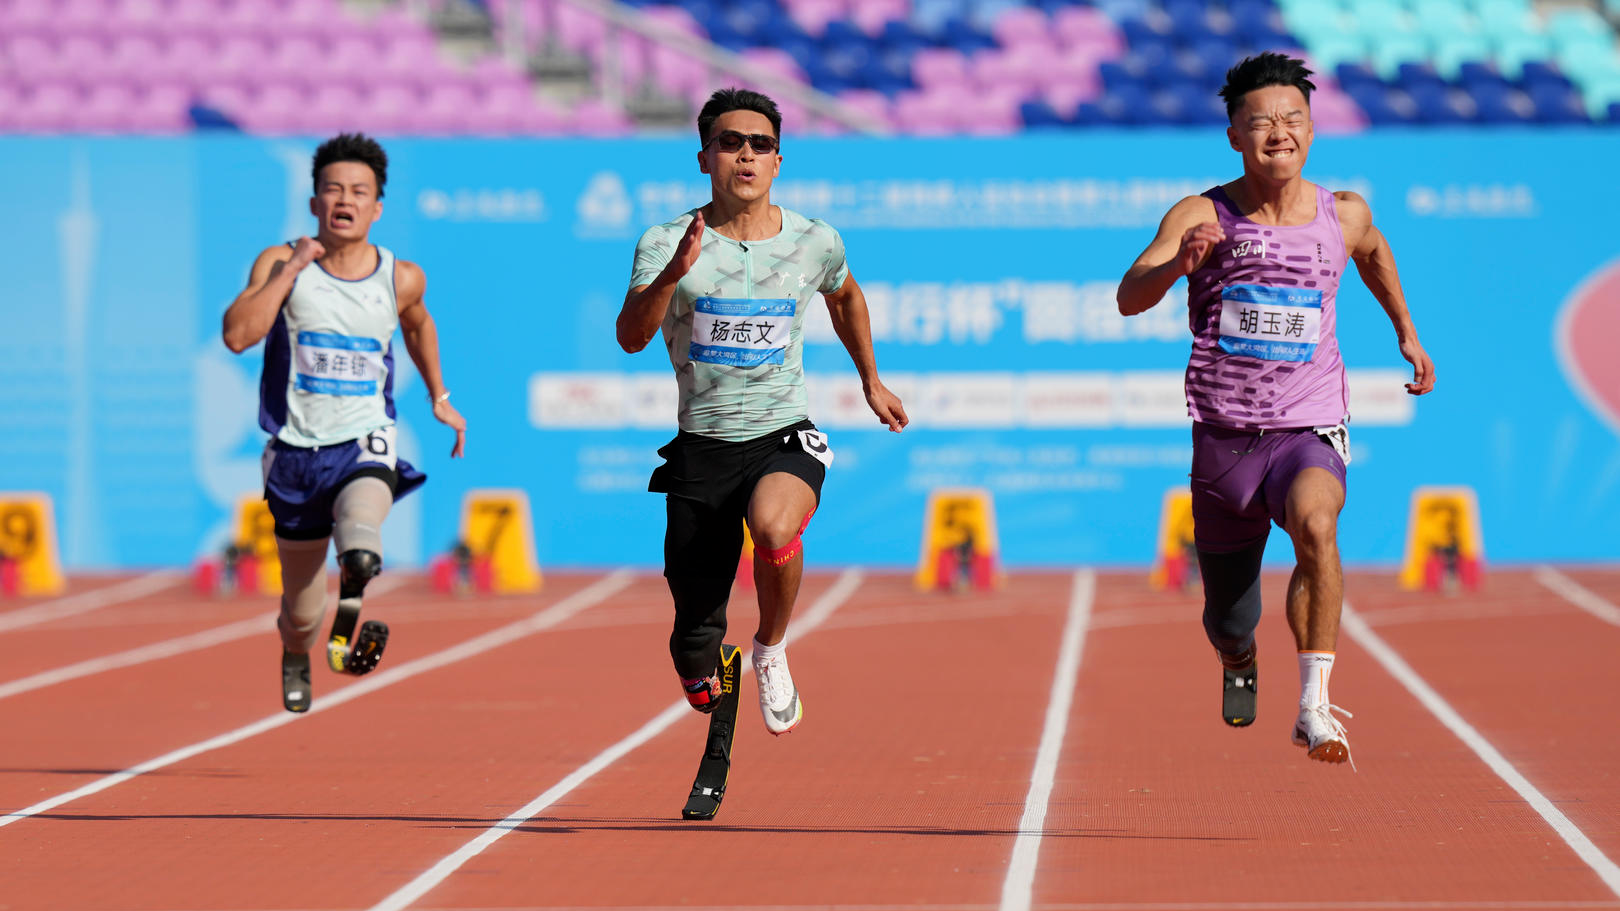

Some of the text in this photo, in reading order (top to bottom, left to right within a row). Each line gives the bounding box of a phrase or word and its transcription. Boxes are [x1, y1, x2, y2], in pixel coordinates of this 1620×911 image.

[1231, 239, 1266, 259] 四川
[710, 319, 775, 345] 杨志文
[1239, 307, 1305, 338] 胡玉涛
[366, 427, 388, 456] 6
[473, 502, 512, 556] 7
[722, 660, 734, 694] SUR
